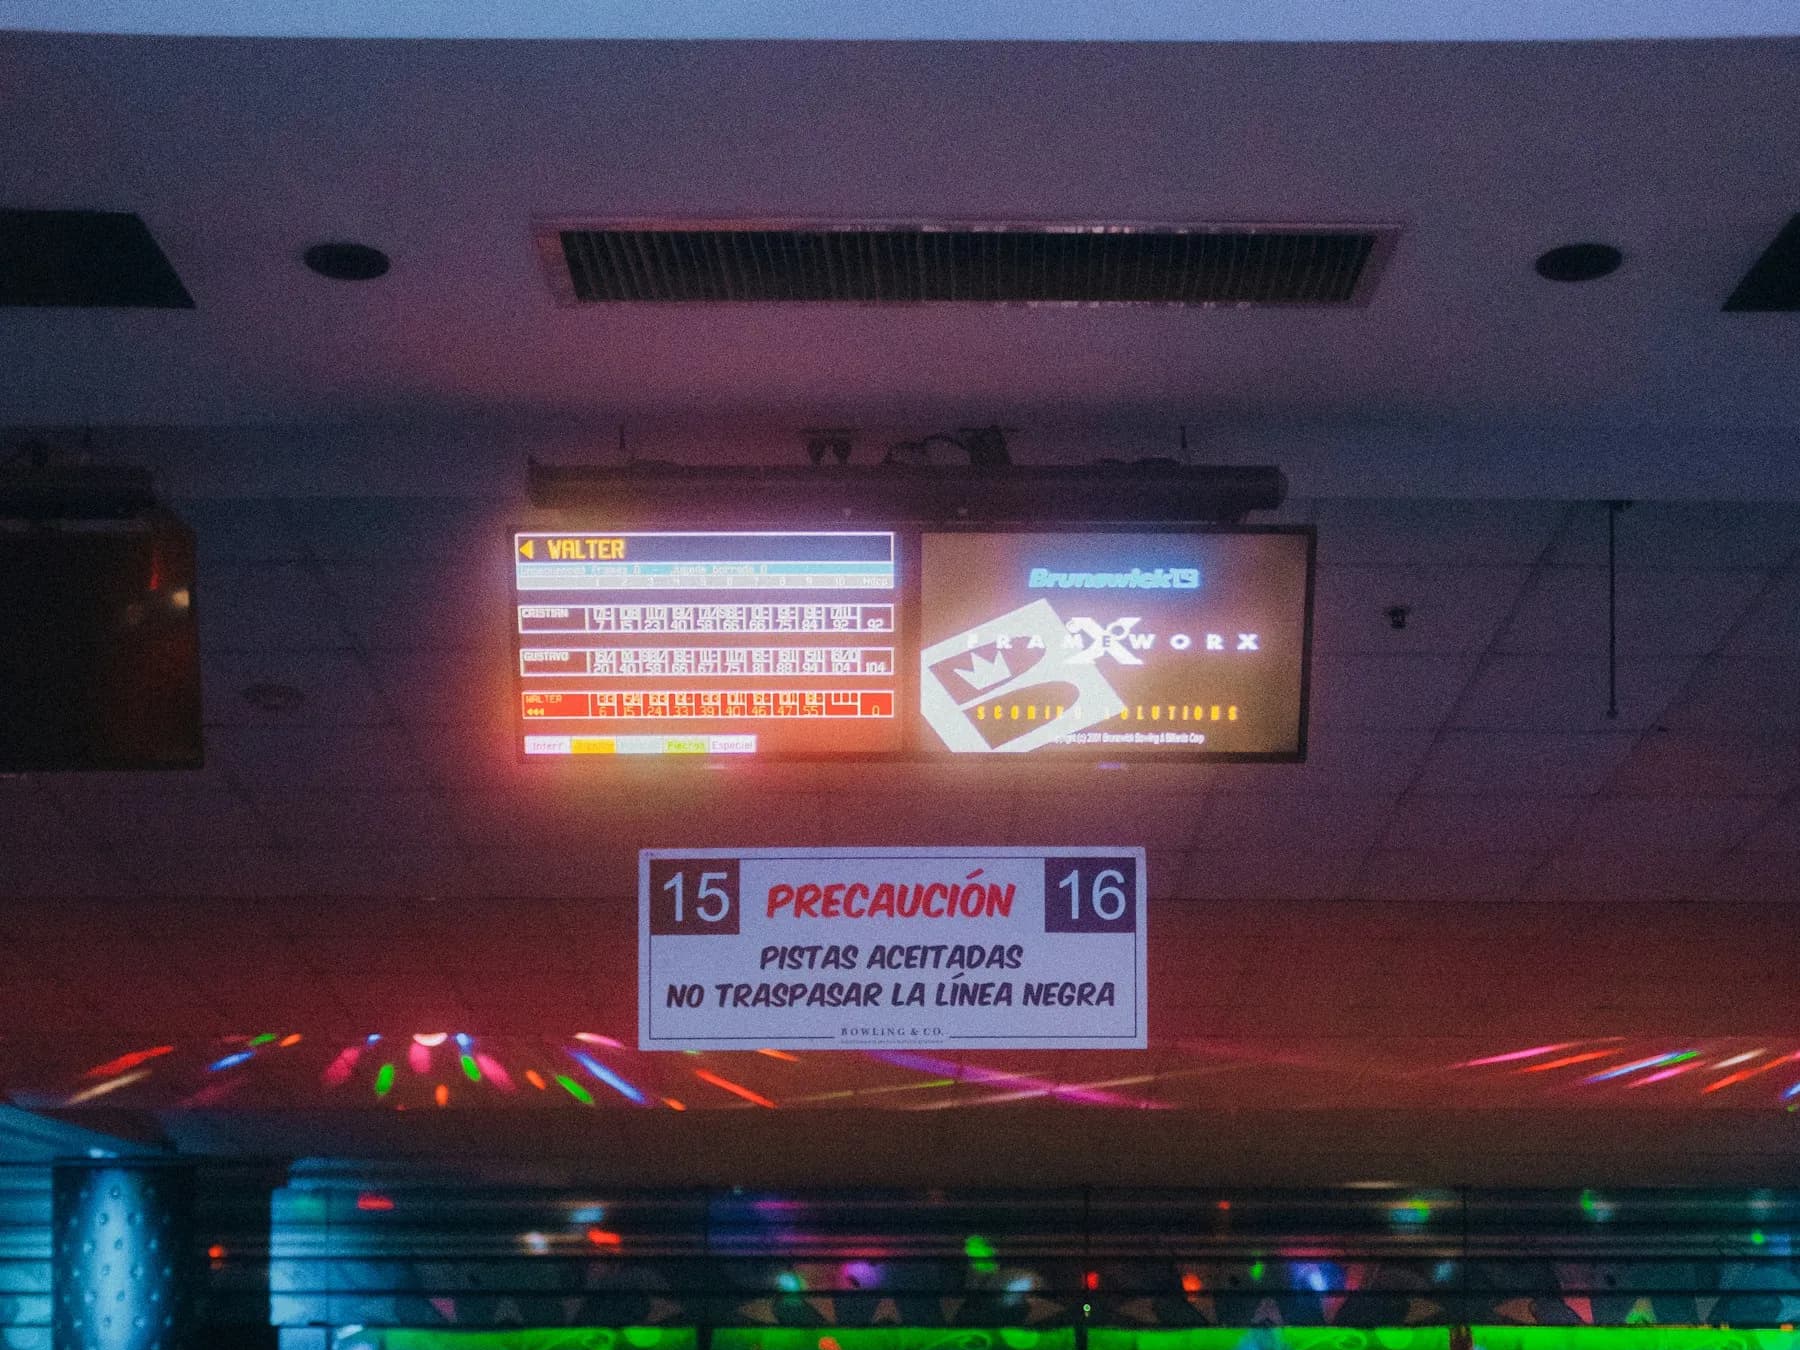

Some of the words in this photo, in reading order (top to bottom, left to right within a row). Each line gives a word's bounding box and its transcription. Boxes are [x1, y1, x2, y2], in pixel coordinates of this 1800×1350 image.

[547, 539, 625, 560] WALTER
[521, 608, 569, 618] CRISTIAN
[867, 618, 884, 629] 92
[524, 652, 569, 662] GUSTAVO
[866, 662, 886, 673] 104
[525, 694, 562, 704] WALTER
[662, 870, 730, 922] 15
[765, 868, 1016, 919] PRECAUCIÓN
[1058, 869, 1127, 921] 16
[760, 944, 859, 970] PISTAS
[867, 943, 1024, 969] ACEITADAS
[666, 983, 704, 1008] NO
[714, 982, 883, 1008] TRASPASAR
[891, 982, 925, 1007] LA
[935, 972, 1013, 1007] LÍNEA
[1021, 981, 1116, 1007] NEGRA
[840, 1027, 905, 1037] BOWLING
[910, 1027, 918, 1036] &
